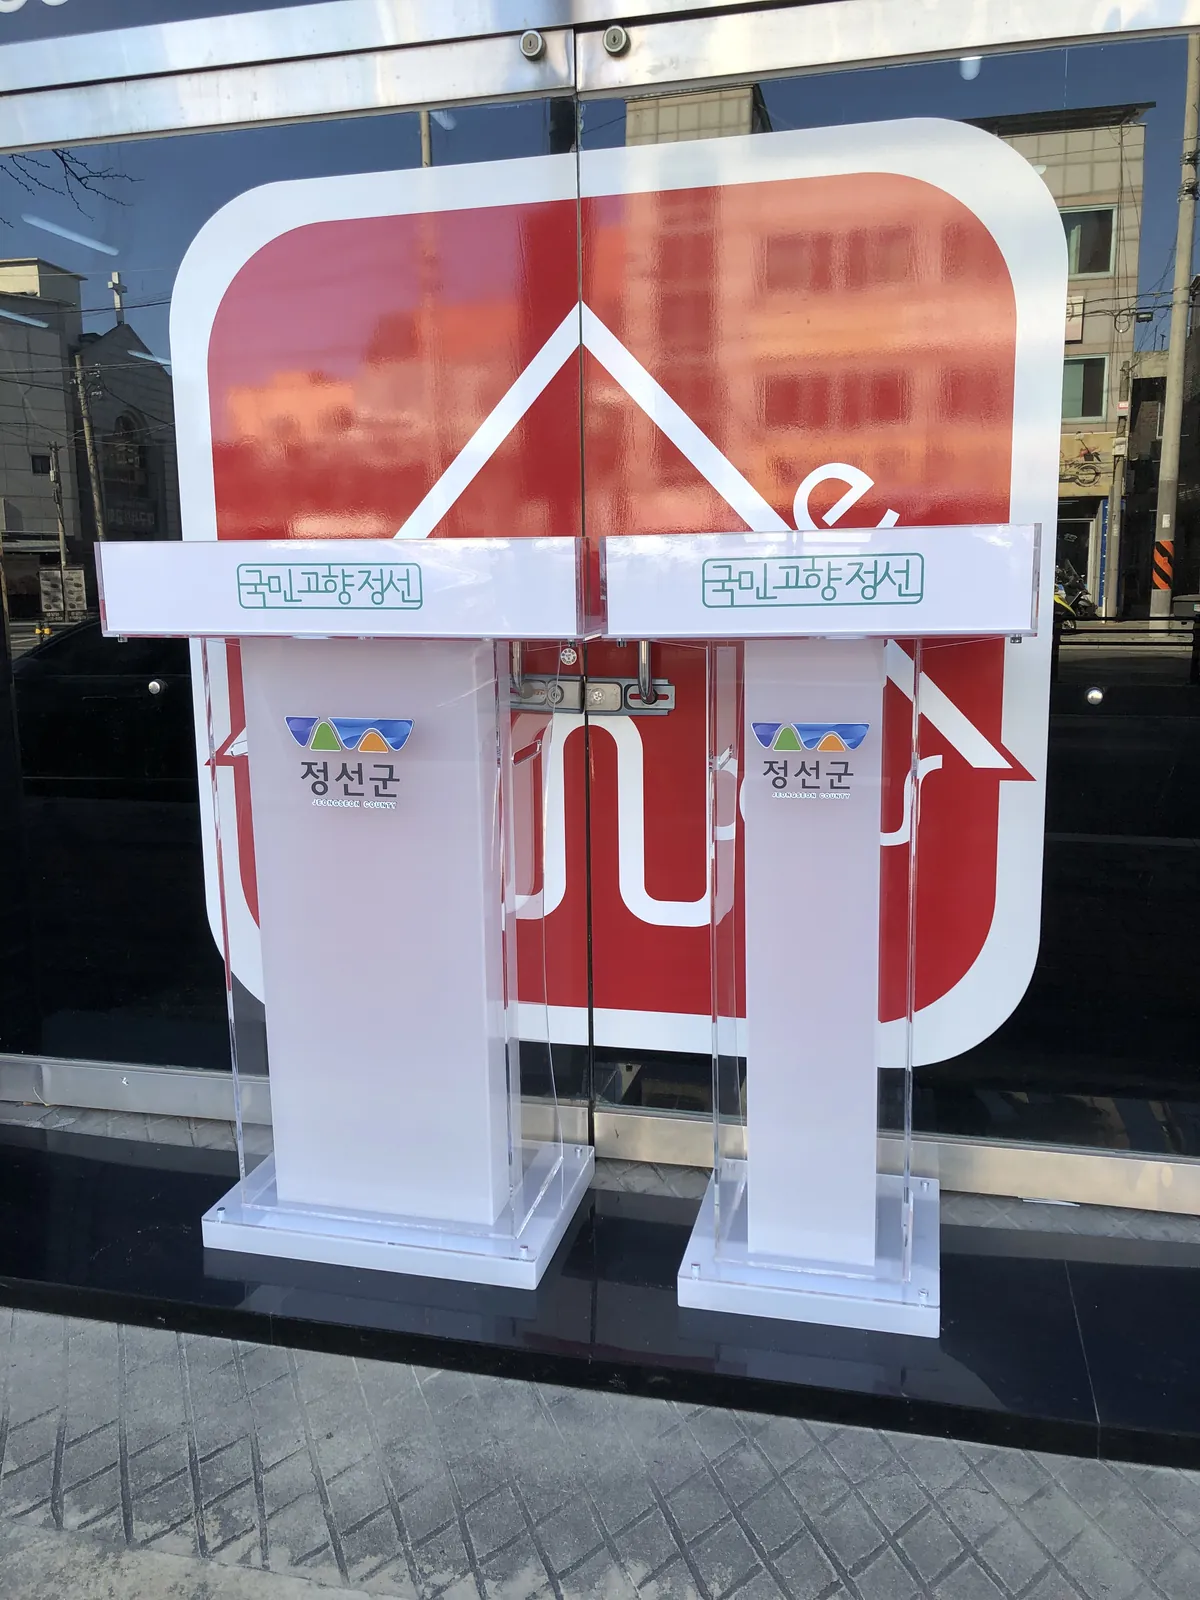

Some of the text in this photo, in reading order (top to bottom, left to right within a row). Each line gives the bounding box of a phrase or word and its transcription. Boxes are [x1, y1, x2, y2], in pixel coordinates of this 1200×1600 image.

[300, 761, 401, 798] 정선군
[762, 759, 855, 790] 정선군
[311, 798, 397, 810] JEONGSEON COUNTY
[771, 791, 851, 800] JEONGSEON COUNTY
